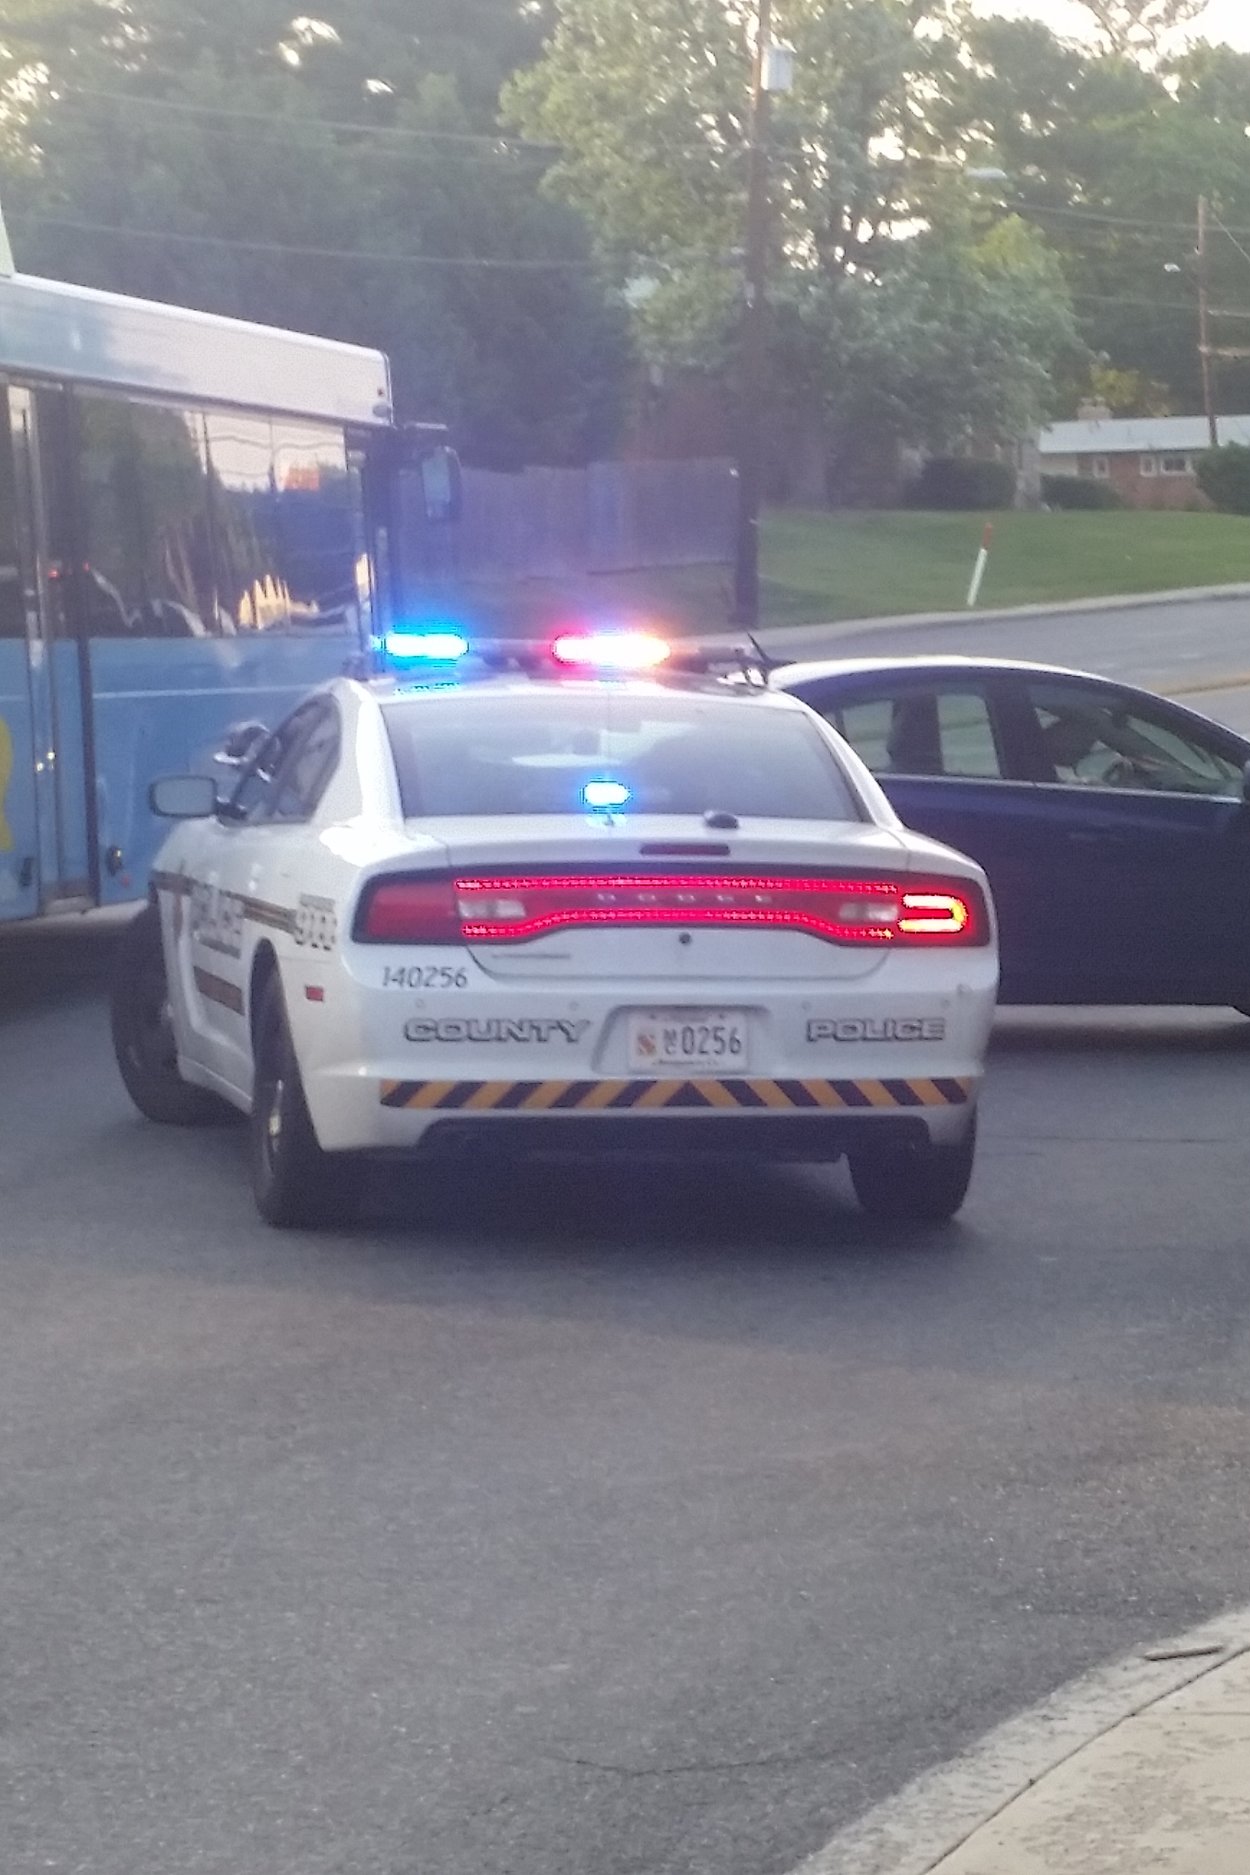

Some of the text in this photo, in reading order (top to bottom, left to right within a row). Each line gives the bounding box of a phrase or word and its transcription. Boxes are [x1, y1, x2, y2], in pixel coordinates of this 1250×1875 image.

[382, 967, 468, 988] 140256
[403, 1016, 591, 1043] COUNTY
[681, 1025, 743, 1055] 0256
[806, 1017, 946, 1042] POLICE
